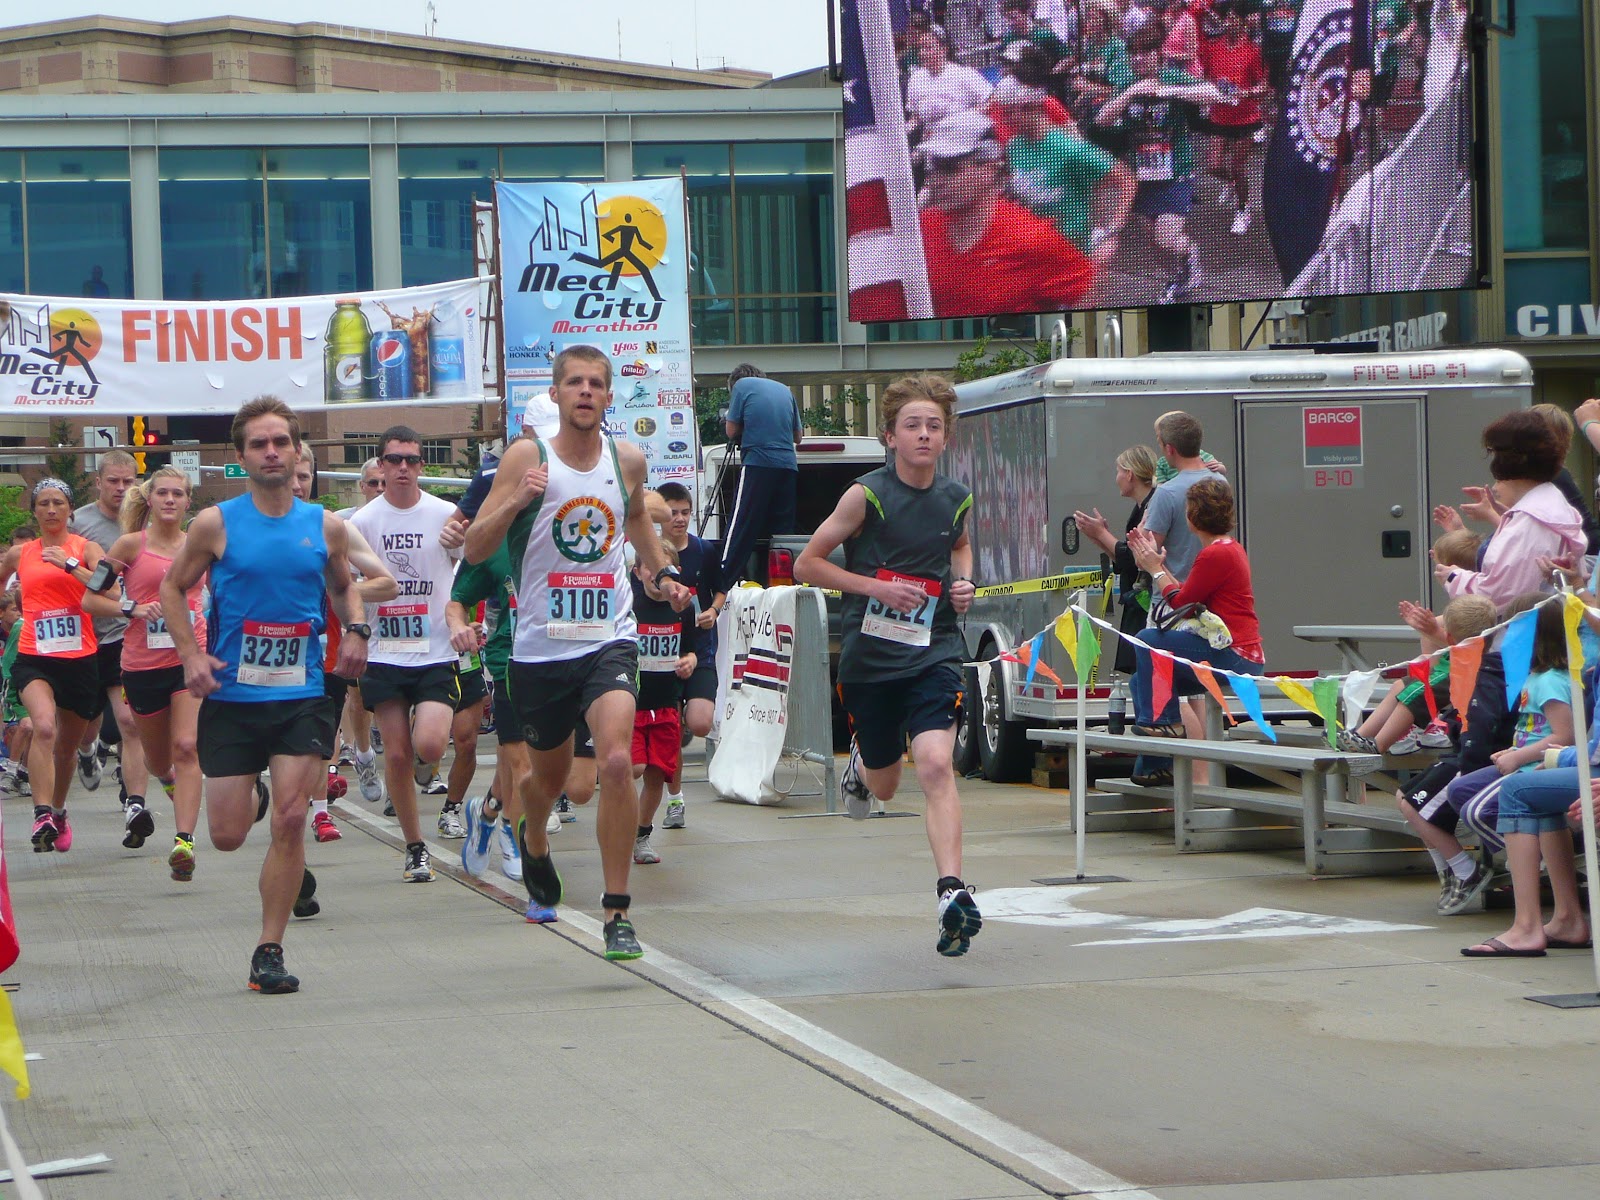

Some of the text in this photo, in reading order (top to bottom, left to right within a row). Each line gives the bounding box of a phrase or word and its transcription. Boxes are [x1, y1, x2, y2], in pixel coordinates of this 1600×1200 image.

[518, 262, 624, 292] Med
[574, 293, 662, 323] City
[552, 319, 658, 334] Marathon
[1394, 311, 1447, 352] RAMP
[1517, 304, 1600, 337] CIV
[121, 306, 303, 363] FINISH
[0, 353, 68, 375] Med
[30, 376, 98, 399] City
[13, 396, 95, 405] Marathon
[664, 394, 685, 404] 1520
[1309, 412, 1357, 424] BARCO
[228, 467, 247, 475] 2 S
[1315, 470, 1353, 487] B-10
[556, 497, 594, 520] MINNESOTA
[382, 533, 423, 550] WEST
[1041, 576, 1070, 590] CAUTION
[551, 588, 608, 619] 3106
[36, 616, 76, 640] 3159
[379, 616, 423, 638] 3013
[244, 636, 301, 667] 3239
[640, 635, 678, 656] 3032
[749, 704, 766, 723] Since
